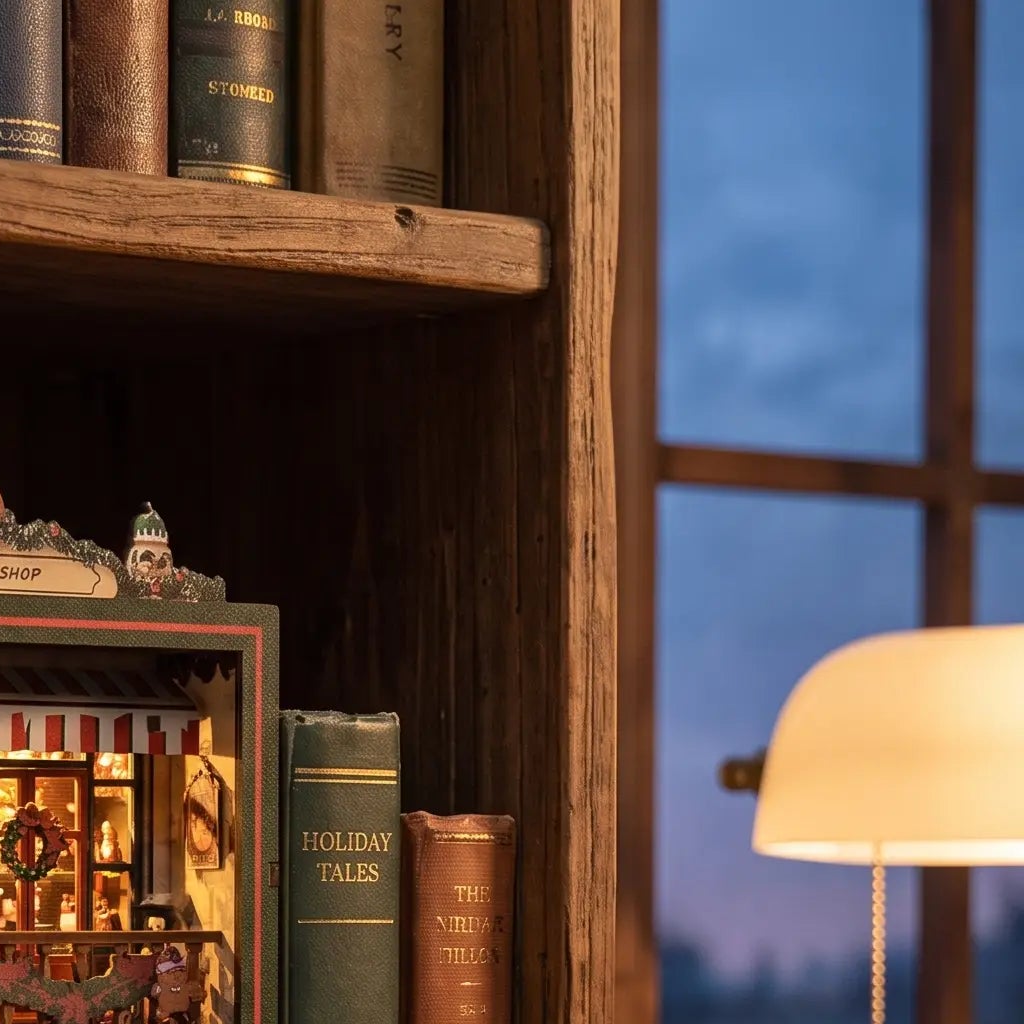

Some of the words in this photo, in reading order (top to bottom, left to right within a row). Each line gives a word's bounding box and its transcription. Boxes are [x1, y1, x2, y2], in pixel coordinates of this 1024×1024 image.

[0, 566, 42, 581] SHOP
[302, 831, 393, 852] HOLIDAY
[316, 862, 380, 882] TALES
[455, 885, 491, 903] THE
